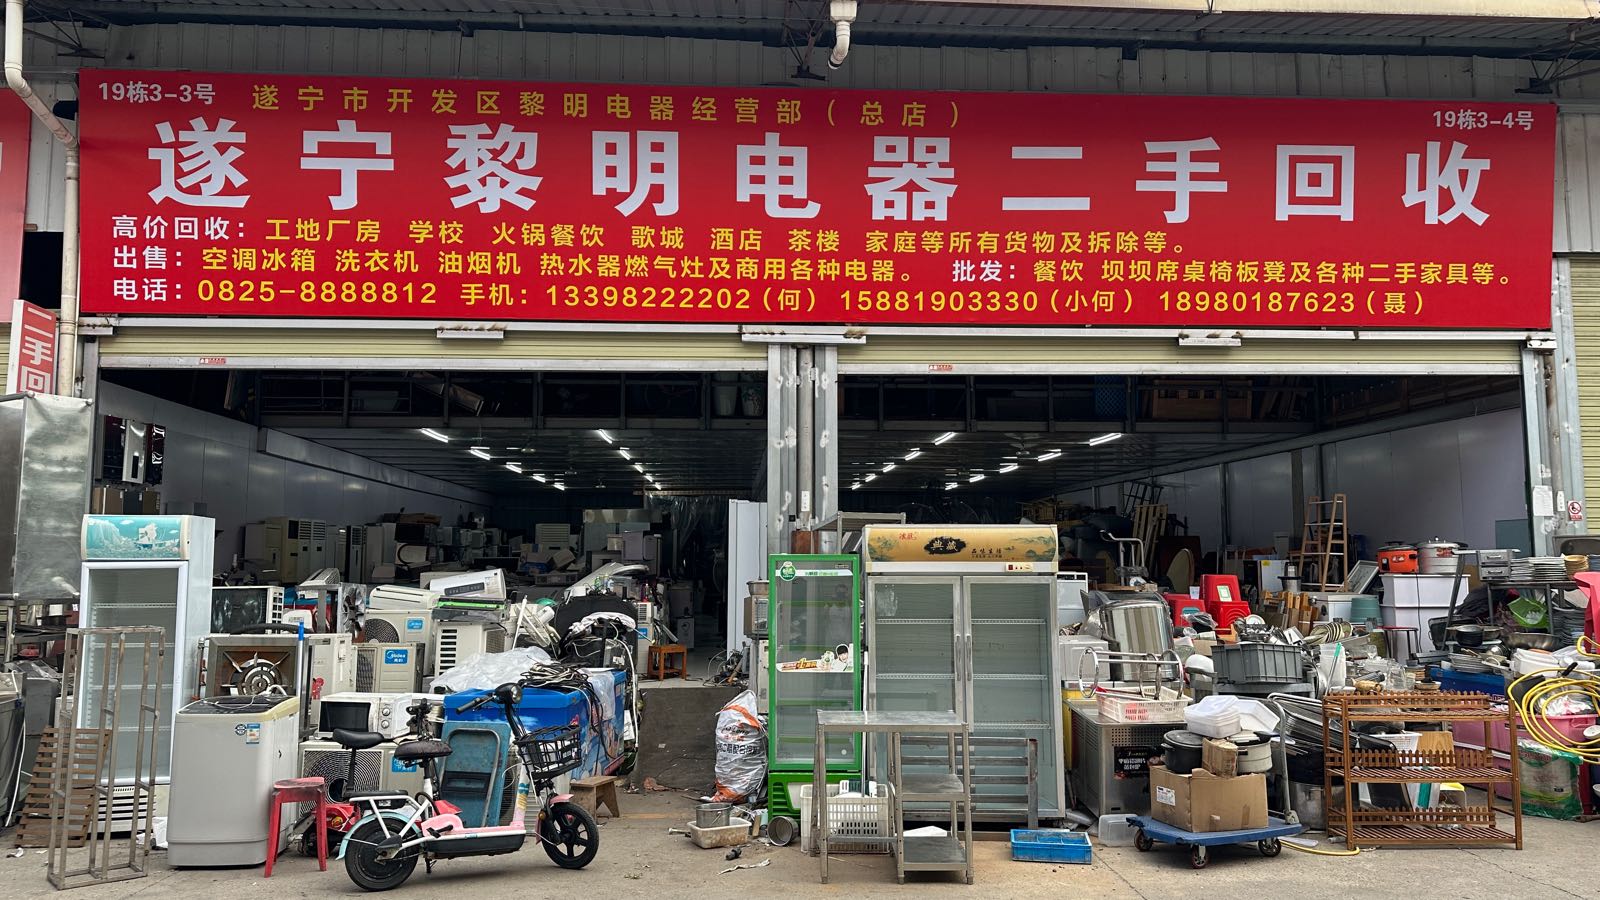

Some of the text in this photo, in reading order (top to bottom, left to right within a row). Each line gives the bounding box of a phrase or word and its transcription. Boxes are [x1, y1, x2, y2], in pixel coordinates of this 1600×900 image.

[98, 80, 216, 106] 19栋3-3号
[1432, 109, 1534, 132] 19栋3-4号
[147, 116, 1491, 227] 遂宁黎明电器二手回收
[264, 217, 381, 244] 工地厂房
[408, 219, 465, 245] 学校
[491, 222, 606, 248] 火锅餐饮
[631, 225, 685, 250] 歌城
[710, 227, 763, 252] 酒店
[788, 229, 840, 253] 茶楼
[865, 230, 1184, 255] 家庭等所有货物及拆除等。
[201, 246, 316, 272] 空调冰箱
[335, 248, 419, 274] 洗衣机
[438, 250, 521, 276] 油烟机
[539, 252, 911, 282] 热水器燃气灶及商用各种电器。
[1033, 259, 1084, 283] 餐饮
[196, 280, 438, 306] 0825-8888812
